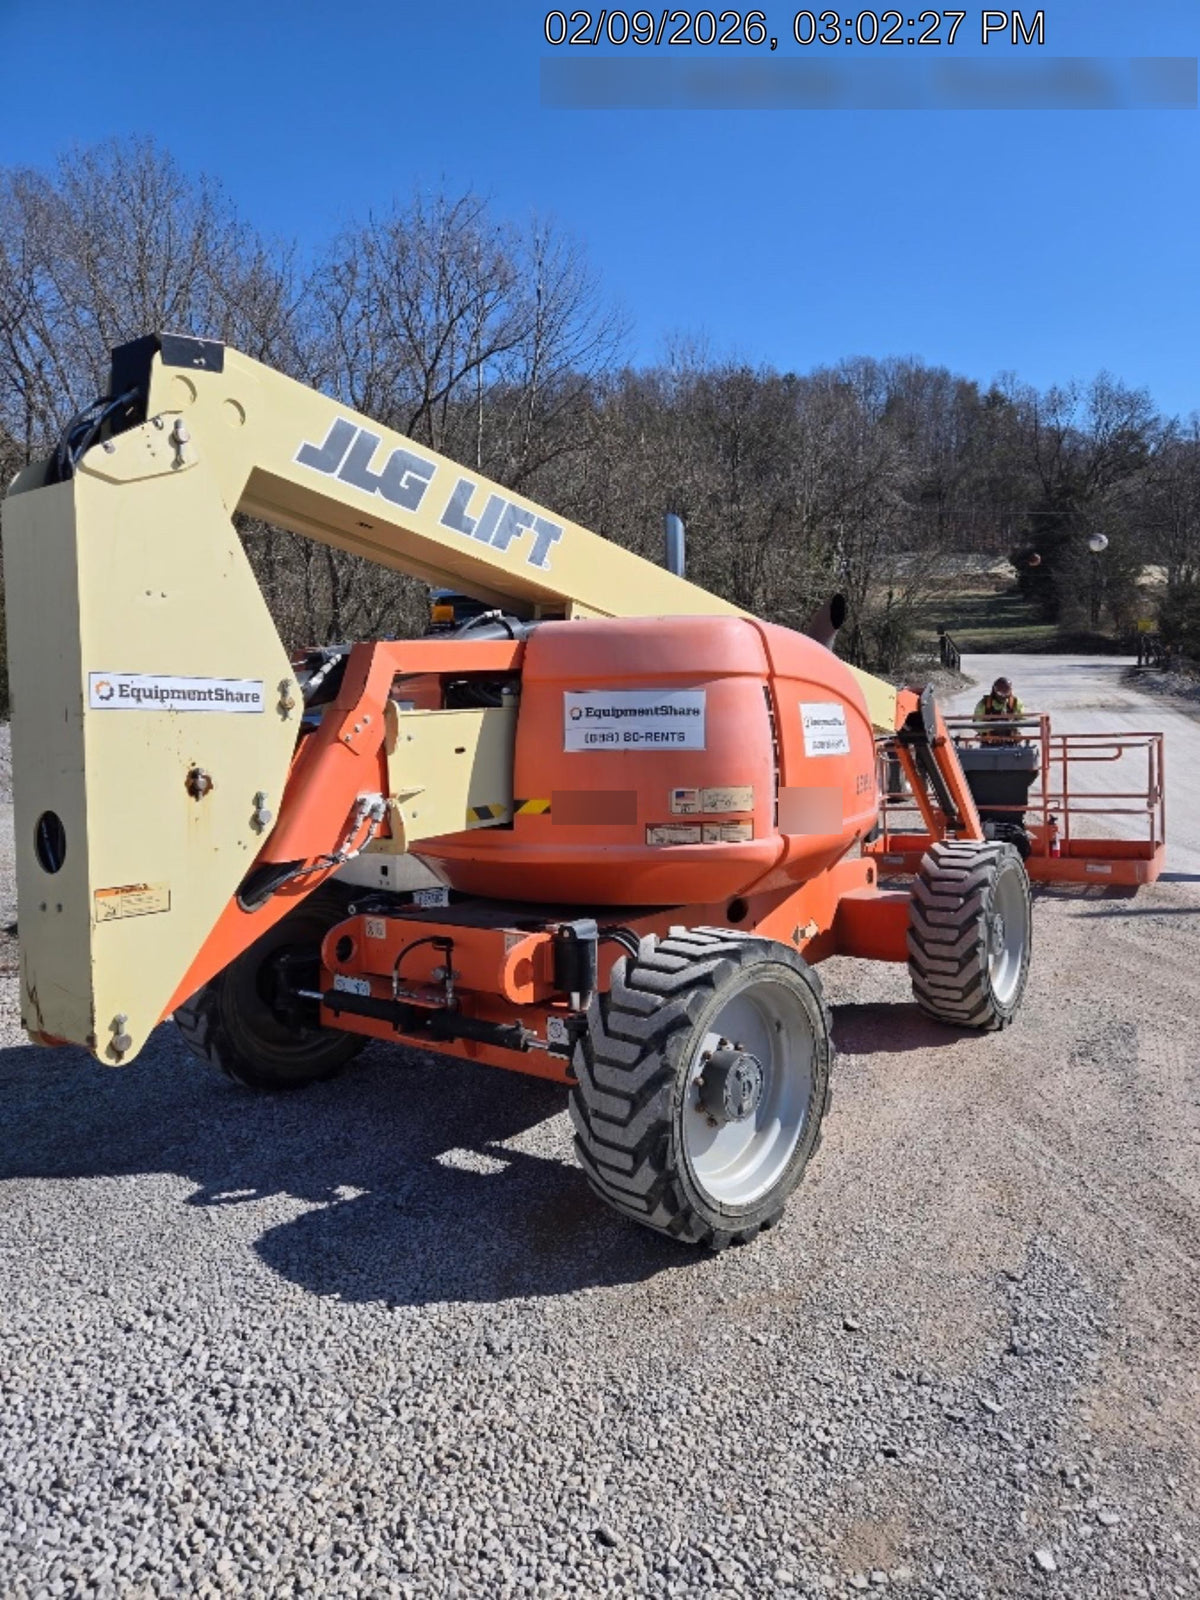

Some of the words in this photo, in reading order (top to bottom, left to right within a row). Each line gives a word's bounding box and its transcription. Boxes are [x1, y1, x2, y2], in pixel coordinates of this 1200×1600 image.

[293, 416, 438, 514] JLG
[440, 477, 565, 568] LIFT
[118, 684, 261, 704] EquipmentShare
[585, 706, 700, 719] EquipmentShare
